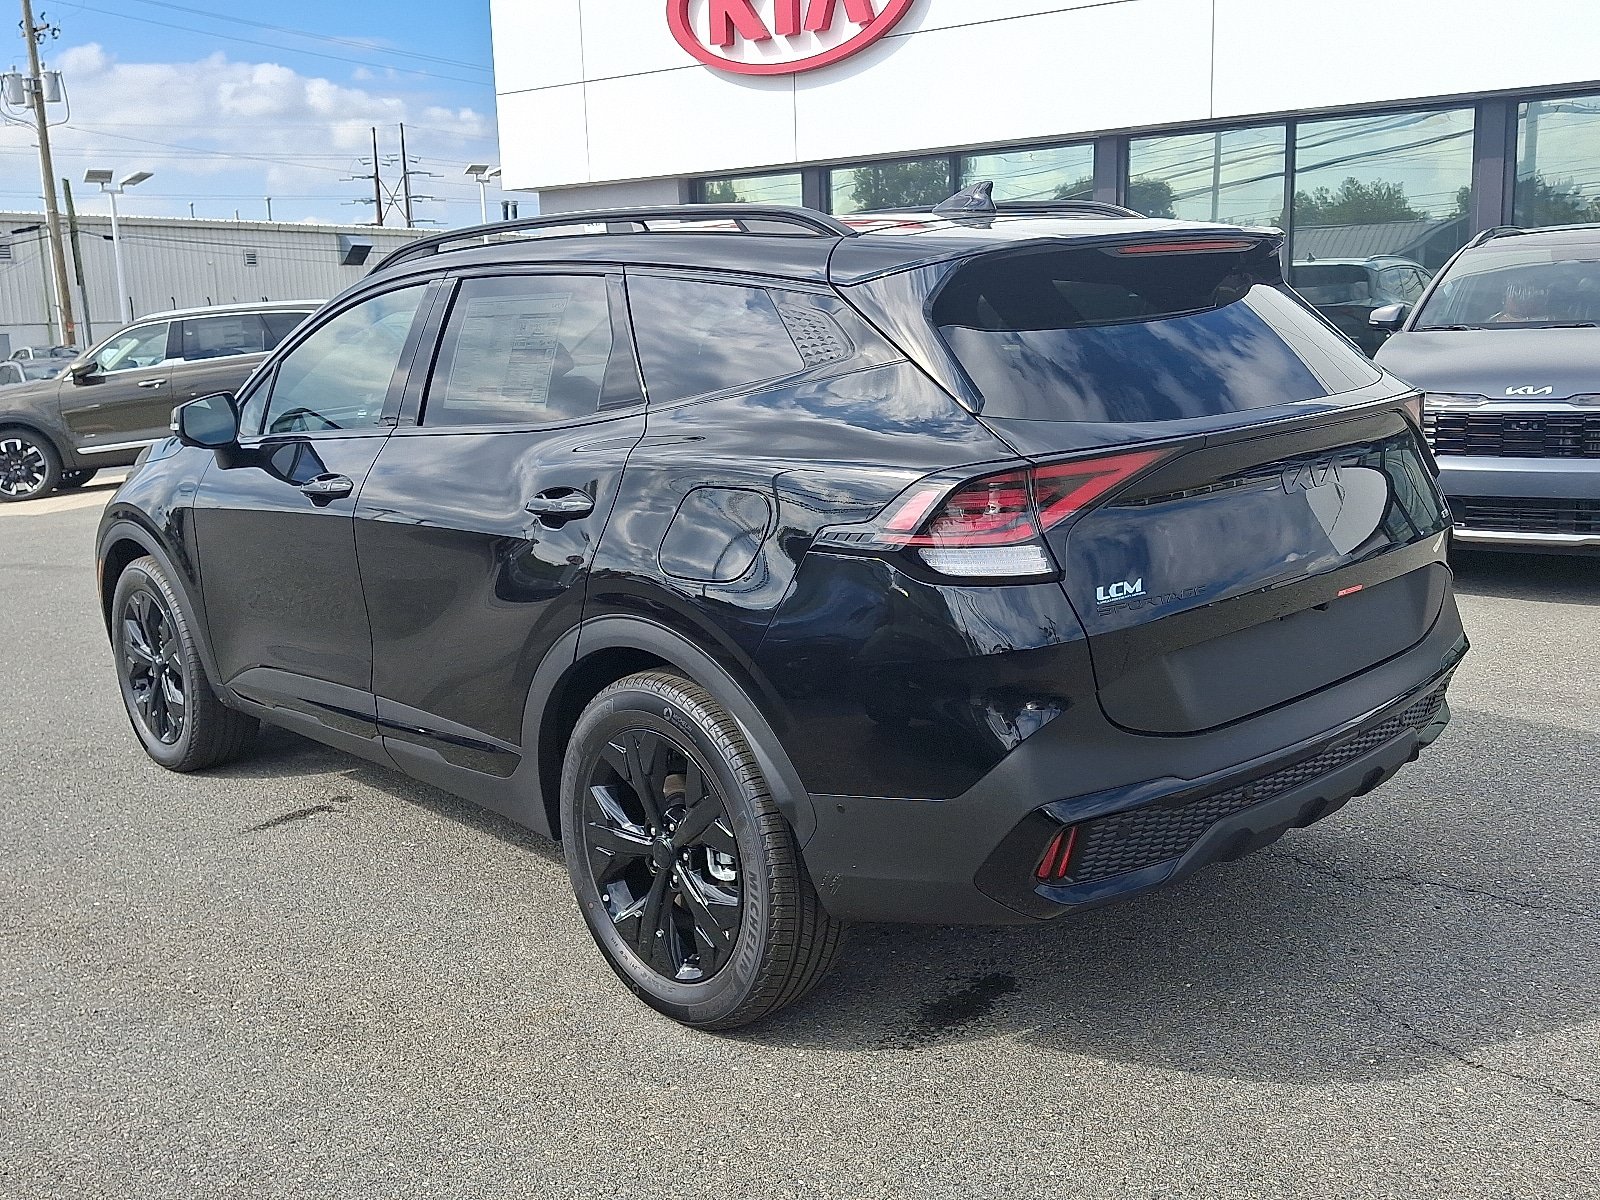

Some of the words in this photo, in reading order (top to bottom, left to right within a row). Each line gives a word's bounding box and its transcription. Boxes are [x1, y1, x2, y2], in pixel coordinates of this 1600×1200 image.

[1505, 385, 1553, 395] KIA
[1096, 577, 1143, 601] LCM
[740, 868, 760, 979] MICHELIN
